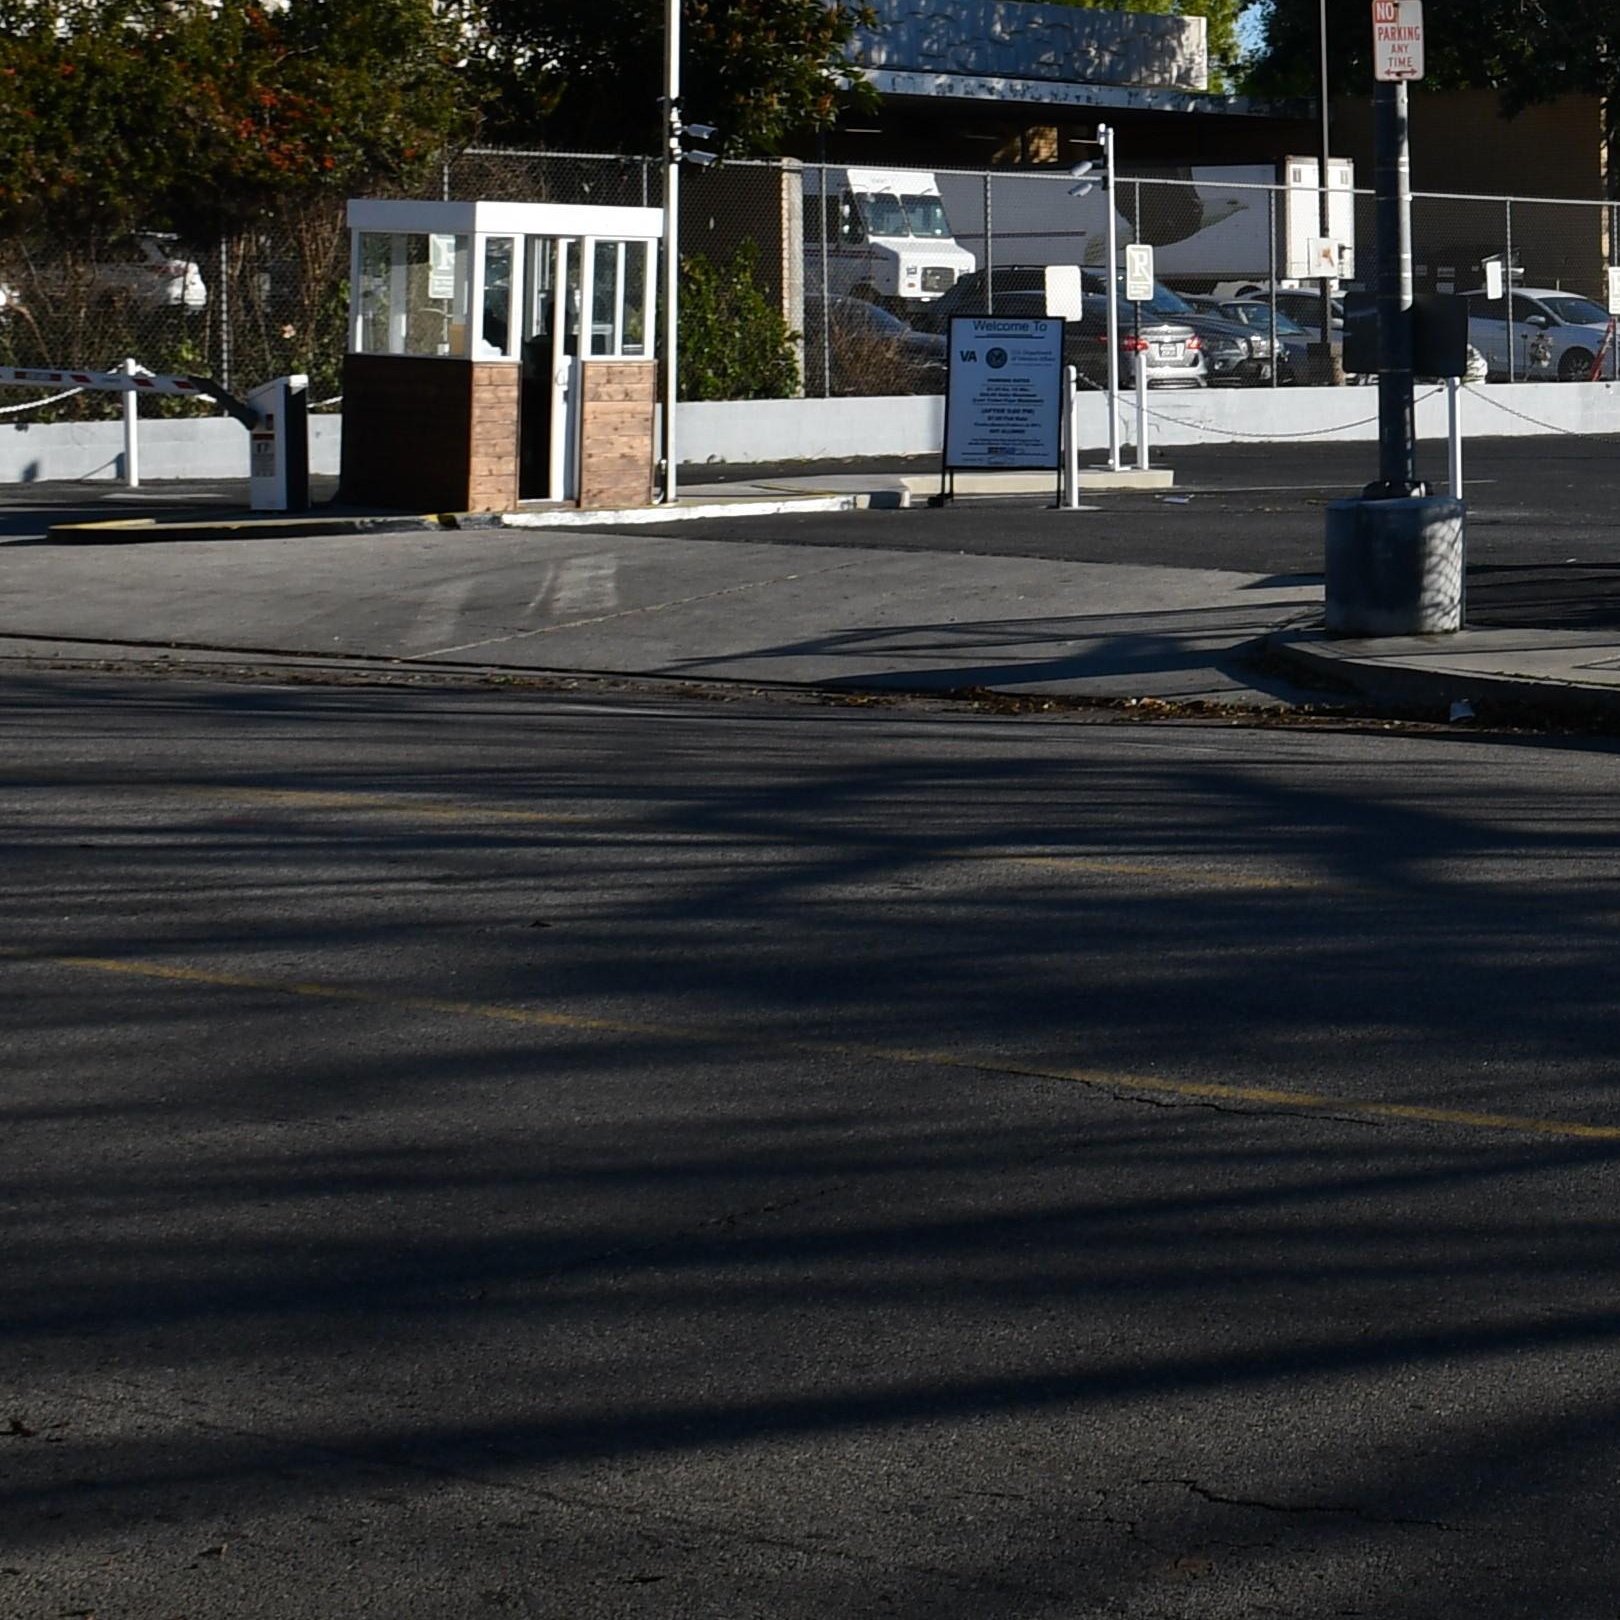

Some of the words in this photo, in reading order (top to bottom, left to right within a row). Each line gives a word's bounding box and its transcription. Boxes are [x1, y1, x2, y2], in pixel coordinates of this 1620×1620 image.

[1376, 2, 1394, 21] NO
[1377, 26, 1420, 41] PARKING
[1391, 44, 1409, 53] ANY
[1388, 57, 1413, 67] TIME
[973, 320, 1029, 332] Welcome
[1033, 321, 1048, 332] To
[960, 350, 977, 363] VA
